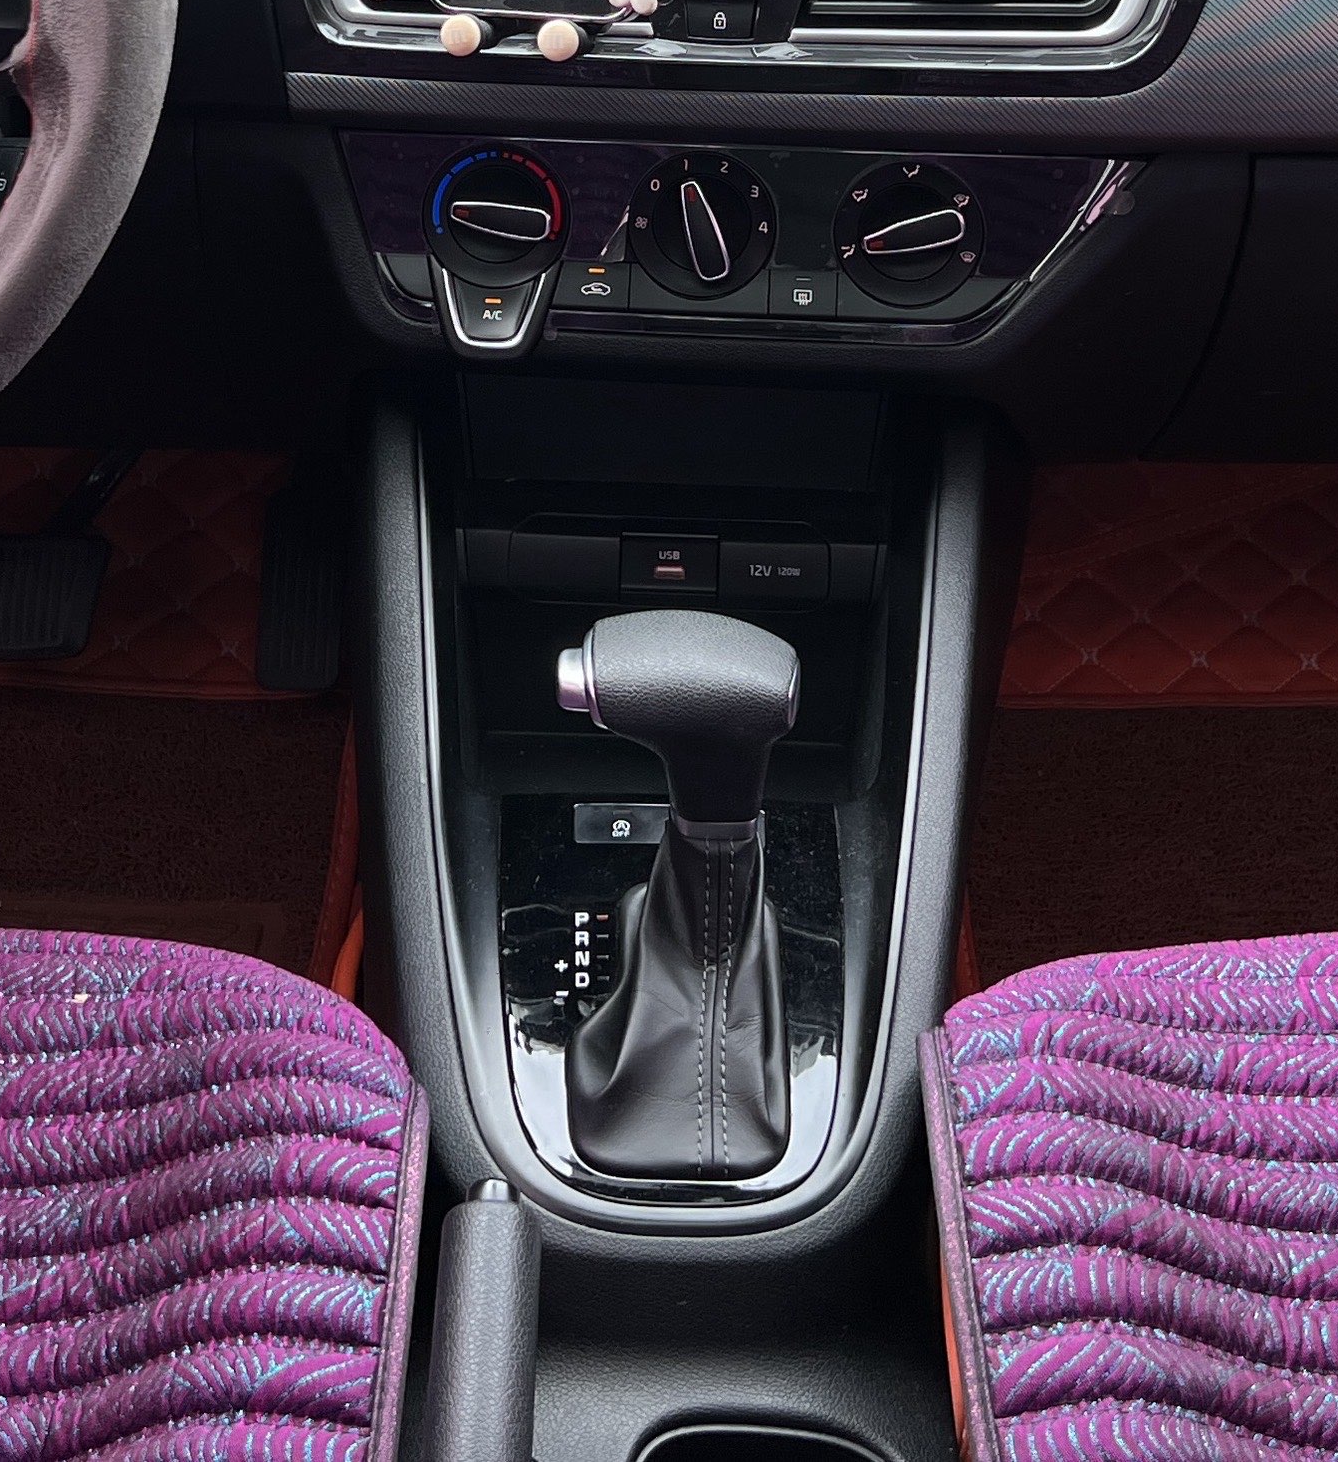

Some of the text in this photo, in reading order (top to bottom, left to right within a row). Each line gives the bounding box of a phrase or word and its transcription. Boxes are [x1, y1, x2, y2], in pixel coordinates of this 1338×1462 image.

[682, 159, 690, 171] 1
[720, 160, 730, 173] 2
[649, 178, 660, 191] 0
[749, 185, 760, 199] 3
[757, 221, 769, 234] 4
[482, 308, 503, 321] A/C
[658, 550, 681, 561] USB
[749, 564, 802, 578] 12V 120W
[574, 911, 590, 927] P
[574, 930, 590, 946] R
[574, 950, 590, 966] N
[574, 972, 590, 988] D
